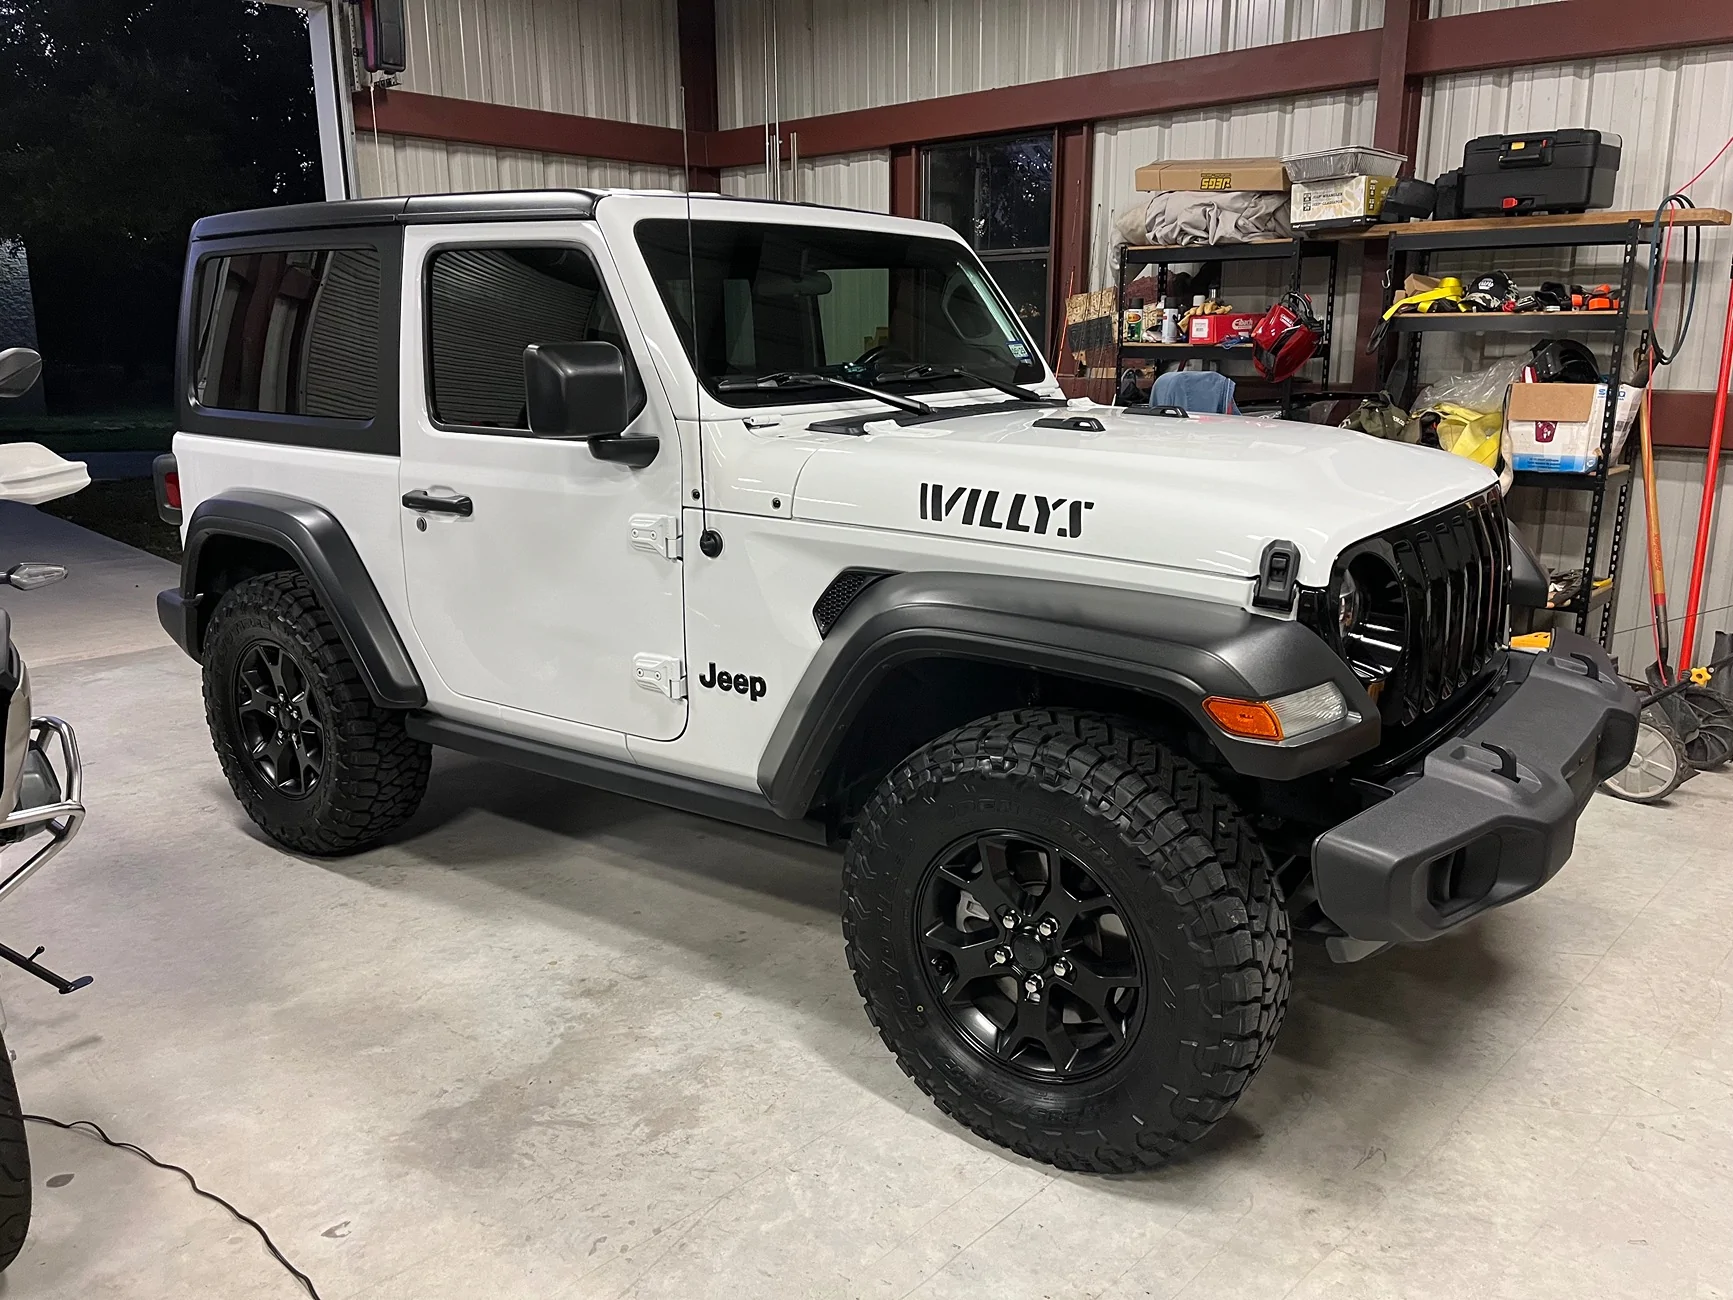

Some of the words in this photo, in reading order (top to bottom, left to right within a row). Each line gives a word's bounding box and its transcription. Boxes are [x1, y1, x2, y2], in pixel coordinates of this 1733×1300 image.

[1200, 177, 1232, 190] JEGS
[920, 483, 1094, 538] WILLYS
[699, 662, 766, 702] Jeep
